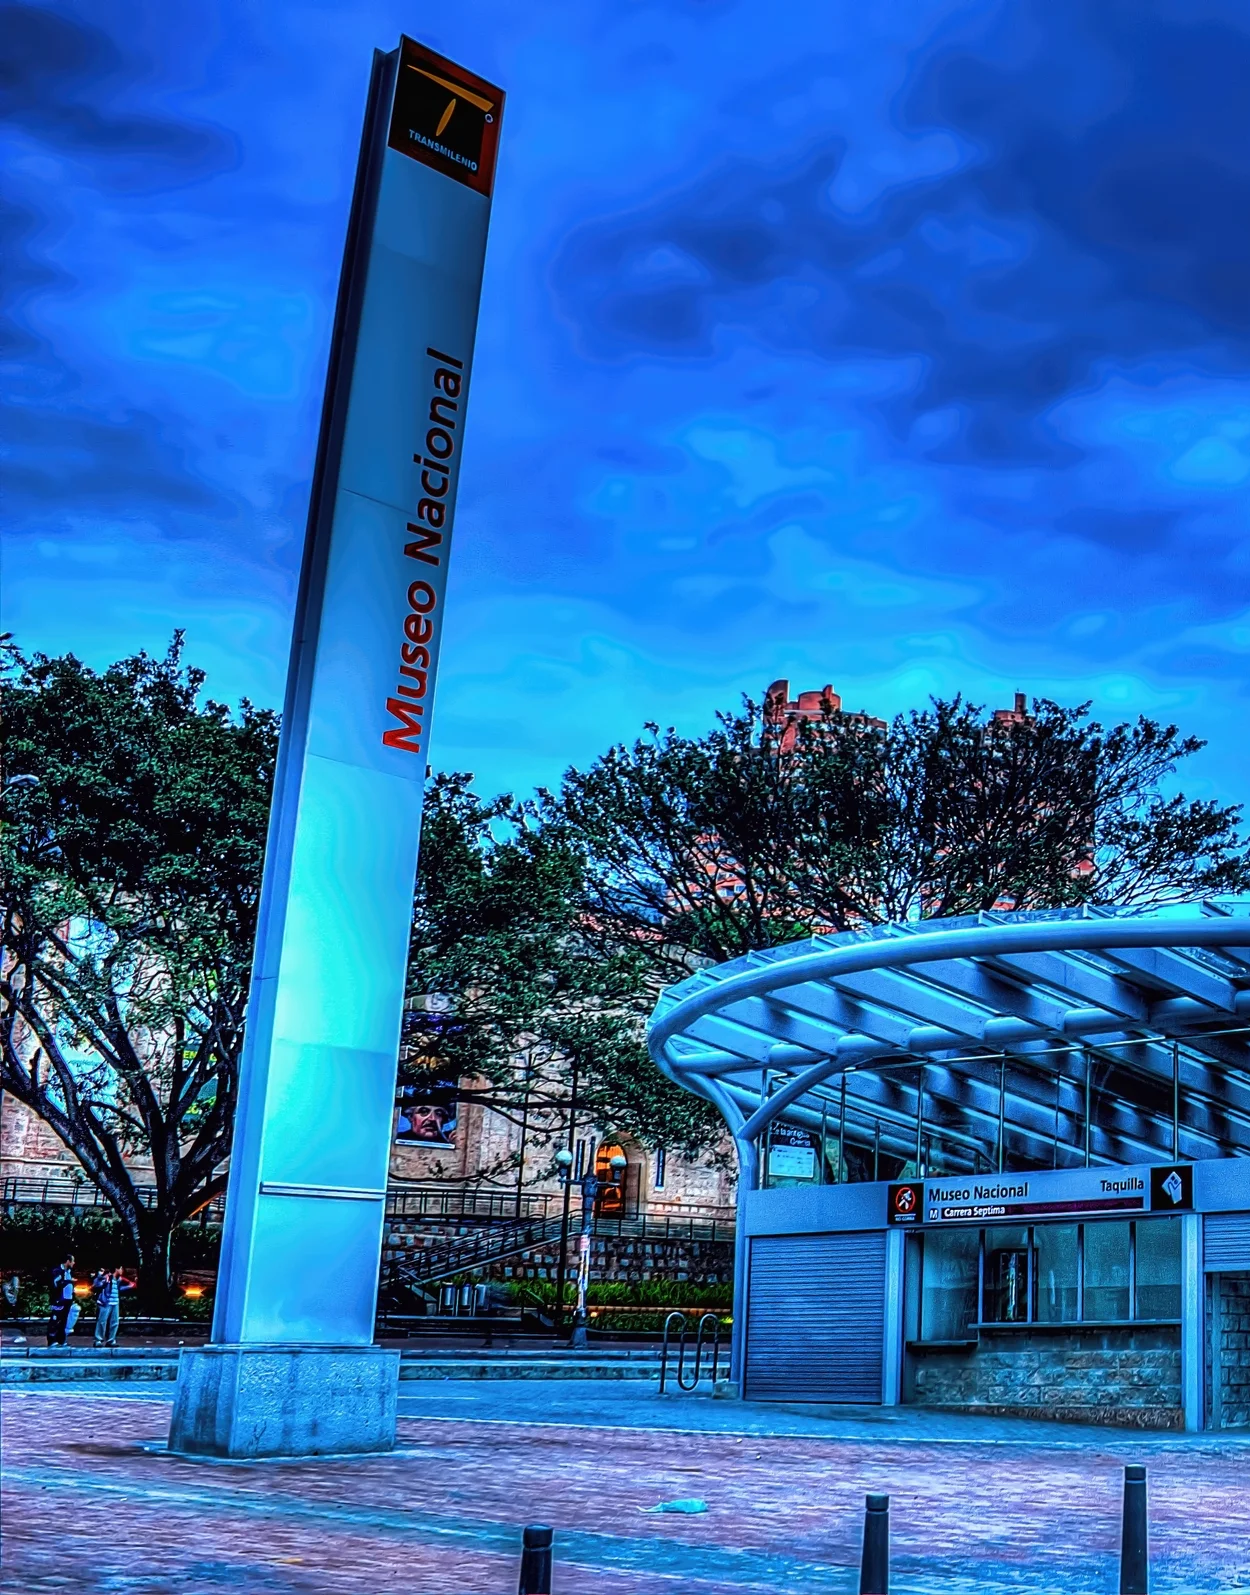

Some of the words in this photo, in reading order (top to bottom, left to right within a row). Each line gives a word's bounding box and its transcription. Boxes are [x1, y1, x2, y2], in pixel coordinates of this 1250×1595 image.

[408, 128, 478, 171] TRANSMILENIO
[403, 346, 465, 567] Nacional
[381, 579, 437, 754] Museo
[928, 1188, 971, 1202] Museo
[973, 1182, 1029, 1200] Nacional
[1100, 1177, 1145, 1194] Taquilla
[944, 1207, 972, 1217] Carrera
